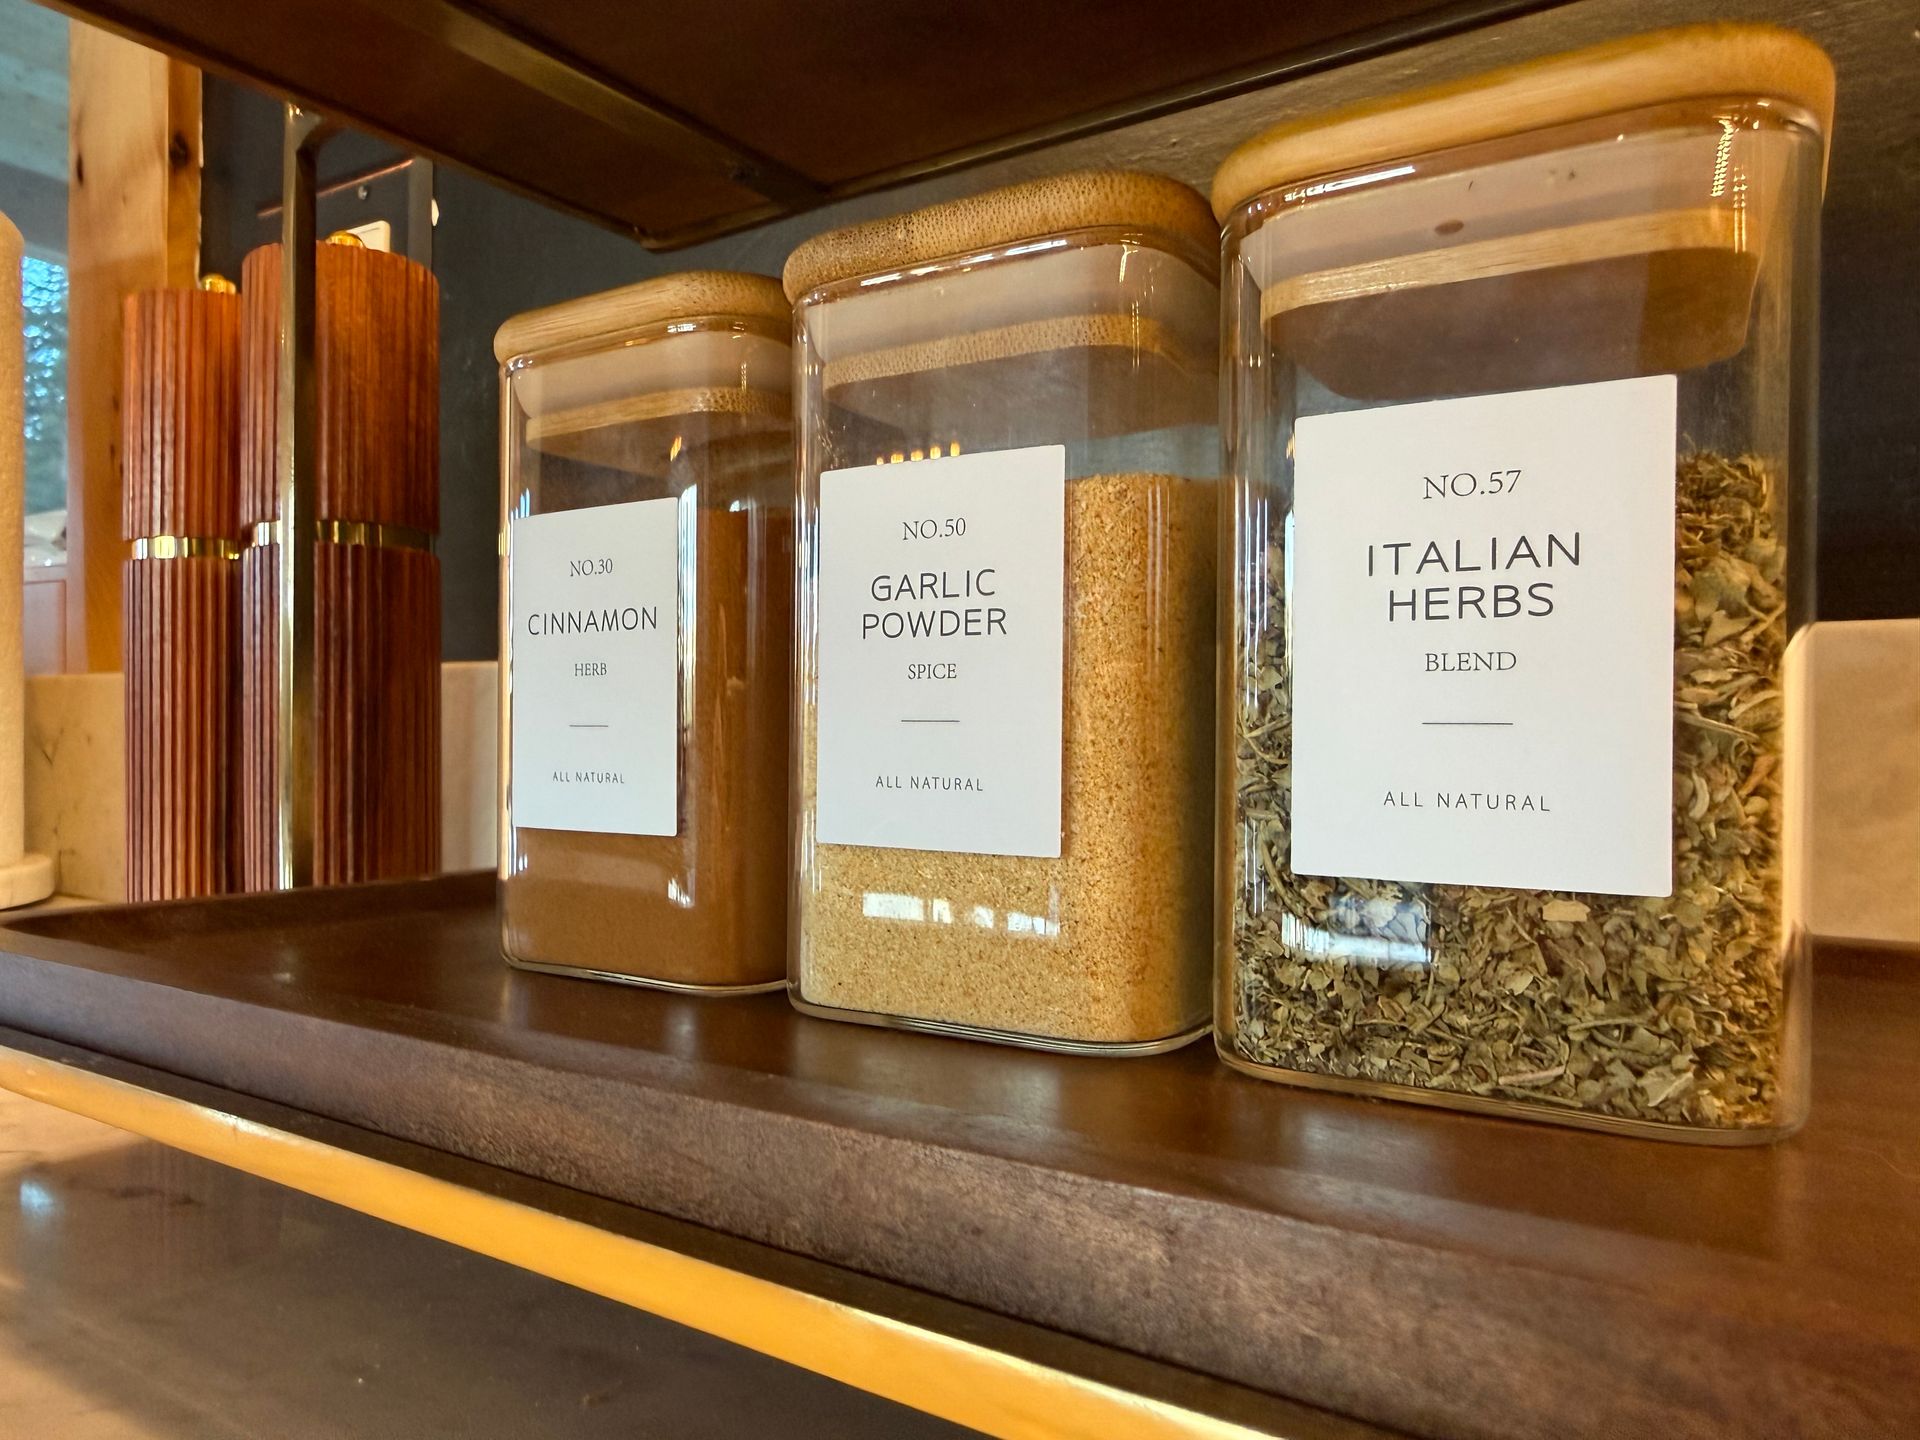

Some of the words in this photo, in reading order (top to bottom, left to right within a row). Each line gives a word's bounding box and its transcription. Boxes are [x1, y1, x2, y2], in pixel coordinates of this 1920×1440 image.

[1422, 469, 1522, 500] NO.57
[902, 517, 967, 541] NO.50
[1368, 531, 1581, 577] ITALIAN
[569, 557, 614, 578] NO.30
[871, 568, 996, 602] GARLIC
[1388, 582, 1555, 623] HERBS
[527, 606, 658, 636] CINNAMON
[862, 607, 1008, 640] POWDER
[574, 662, 608, 677] HERB
[907, 663, 958, 681] SPICE
[1424, 651, 1518, 672] BLEND
[552, 771, 570, 783] ALL
[575, 771, 625, 785] NATURAL
[875, 775, 903, 789] ALL
[910, 776, 984, 792] NATURAL
[1383, 790, 1424, 808] ALL
[1437, 792, 1551, 813] NATURAL
